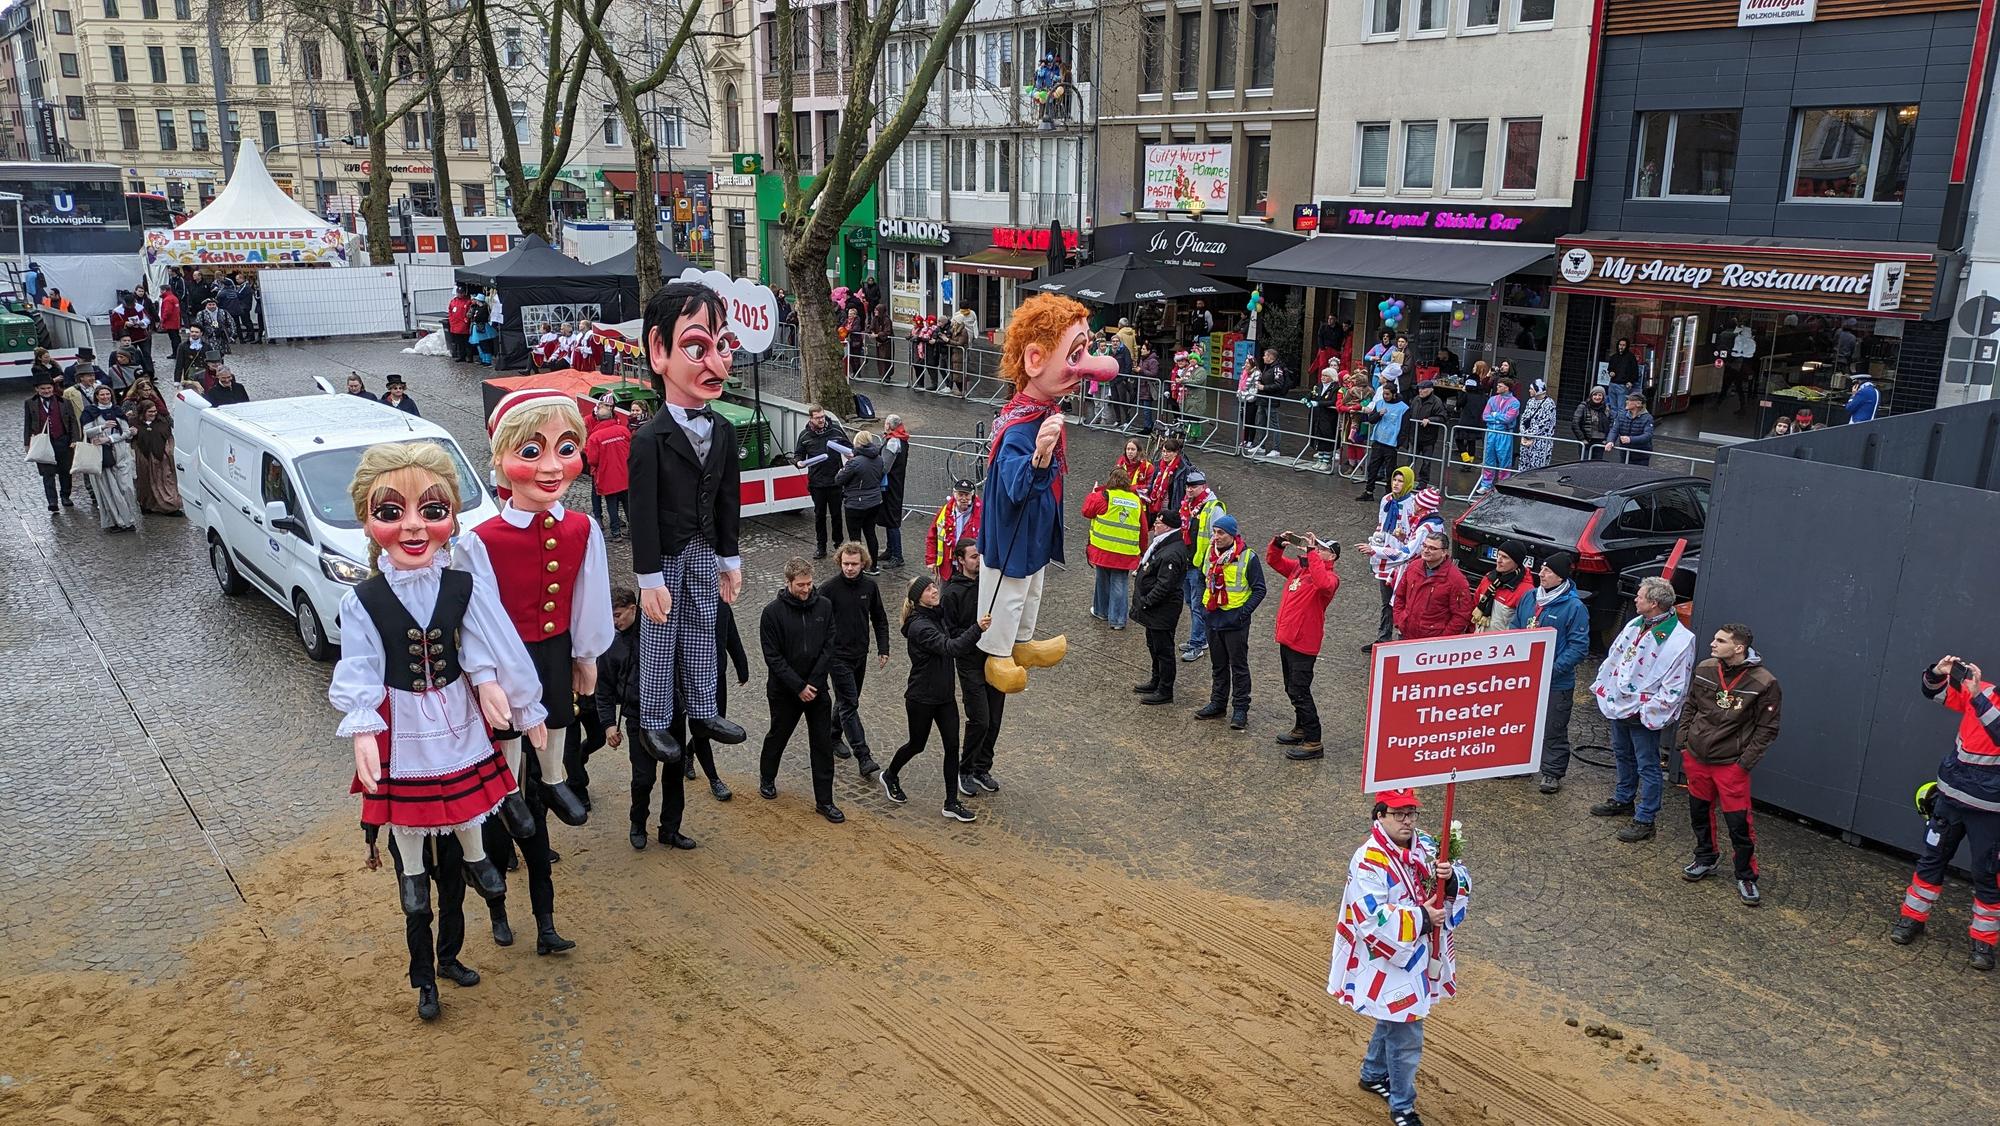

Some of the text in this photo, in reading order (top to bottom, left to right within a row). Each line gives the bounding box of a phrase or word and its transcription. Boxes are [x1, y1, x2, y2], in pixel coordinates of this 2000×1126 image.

[1745, 9, 1806, 20] HOLZKOHLEGRILL
[43, 110, 53, 136] BARISTA
[343, 163, 361, 172] KVB
[718, 175, 733, 186] COFFEE
[733, 176, 752, 186] FELLOWS
[1148, 169, 1178, 183] PIZZA
[1147, 185, 1174, 199] PASTA
[53, 194, 74, 212] U
[661, 211, 671, 221] U
[1302, 206, 1313, 217] sky
[28, 215, 104, 226] Chlodwigplatz
[1348, 208, 1523, 231] The Legend Shisha Bar
[173, 229, 318, 241] Bratwurst
[189, 239, 306, 251] Pommes
[1146, 229, 1228, 256] In Piazza
[199, 250, 246, 264] Kölle
[1163, 258, 1180, 266] cucina
[1599, 256, 1872, 294] My Antep Restaurant
[733, 298, 769, 331] 2025
[1415, 644, 1516, 666] Gruppe 3 A
[1391, 675, 1531, 703] Hänneschen
[1416, 702, 1504, 724] Theater
[1387, 721, 1527, 749] Puppenspiele der
[1413, 742, 1496, 762] Stadt Köln
